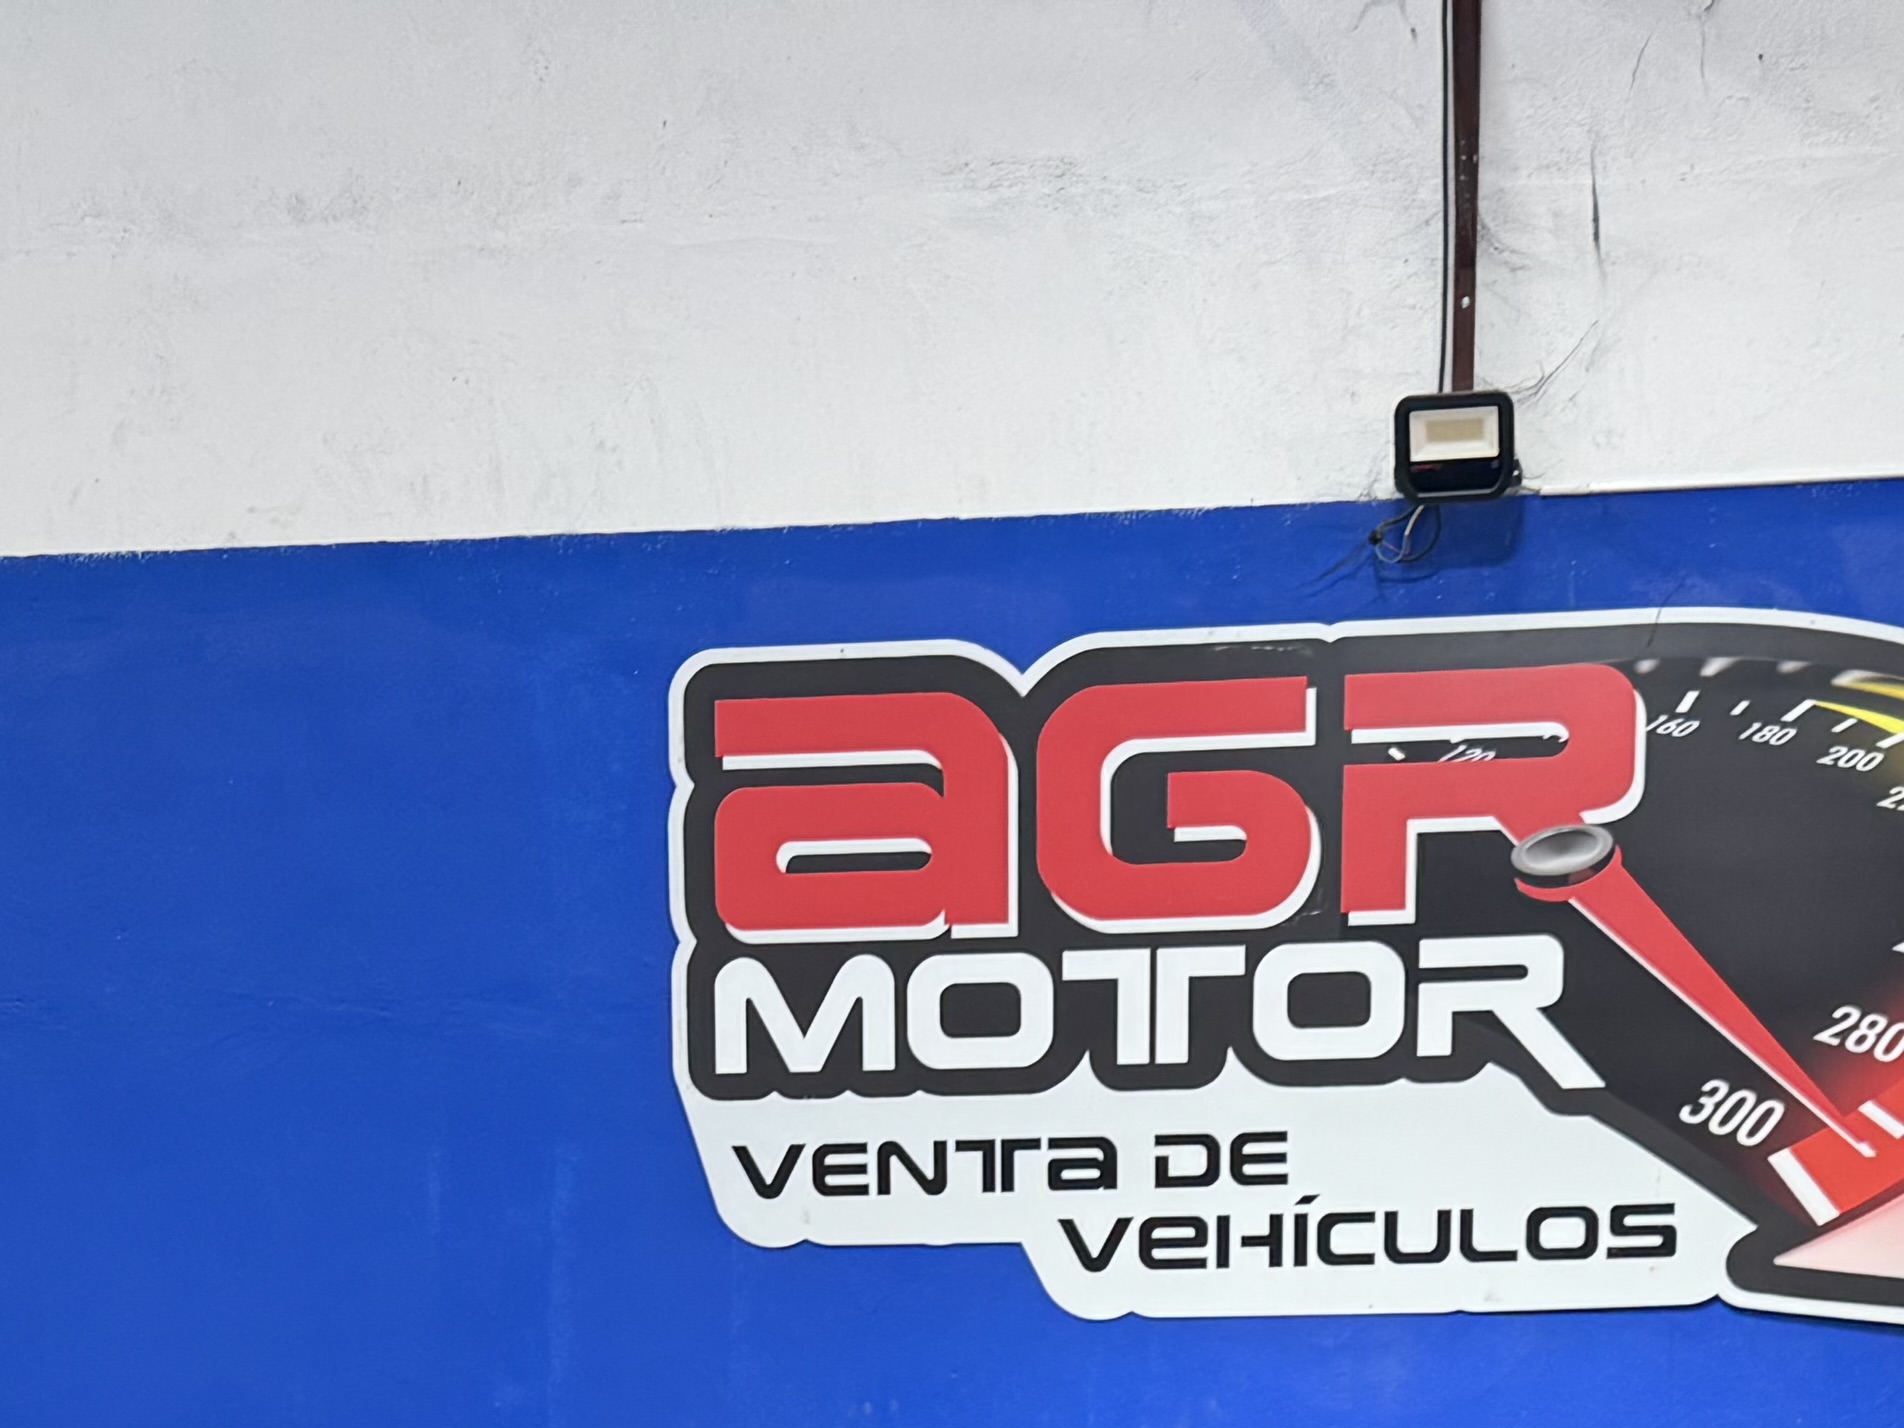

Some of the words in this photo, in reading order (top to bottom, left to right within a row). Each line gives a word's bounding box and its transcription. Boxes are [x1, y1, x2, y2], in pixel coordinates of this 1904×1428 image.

[1644, 713, 1700, 738] 160
[1738, 721, 1798, 747] 180
[1816, 744, 1885, 774] 200
[714, 934, 1606, 1089] MOTOR
[1677, 1078, 1786, 1148] 300
[1153, 1131, 1289, 1190] DE
